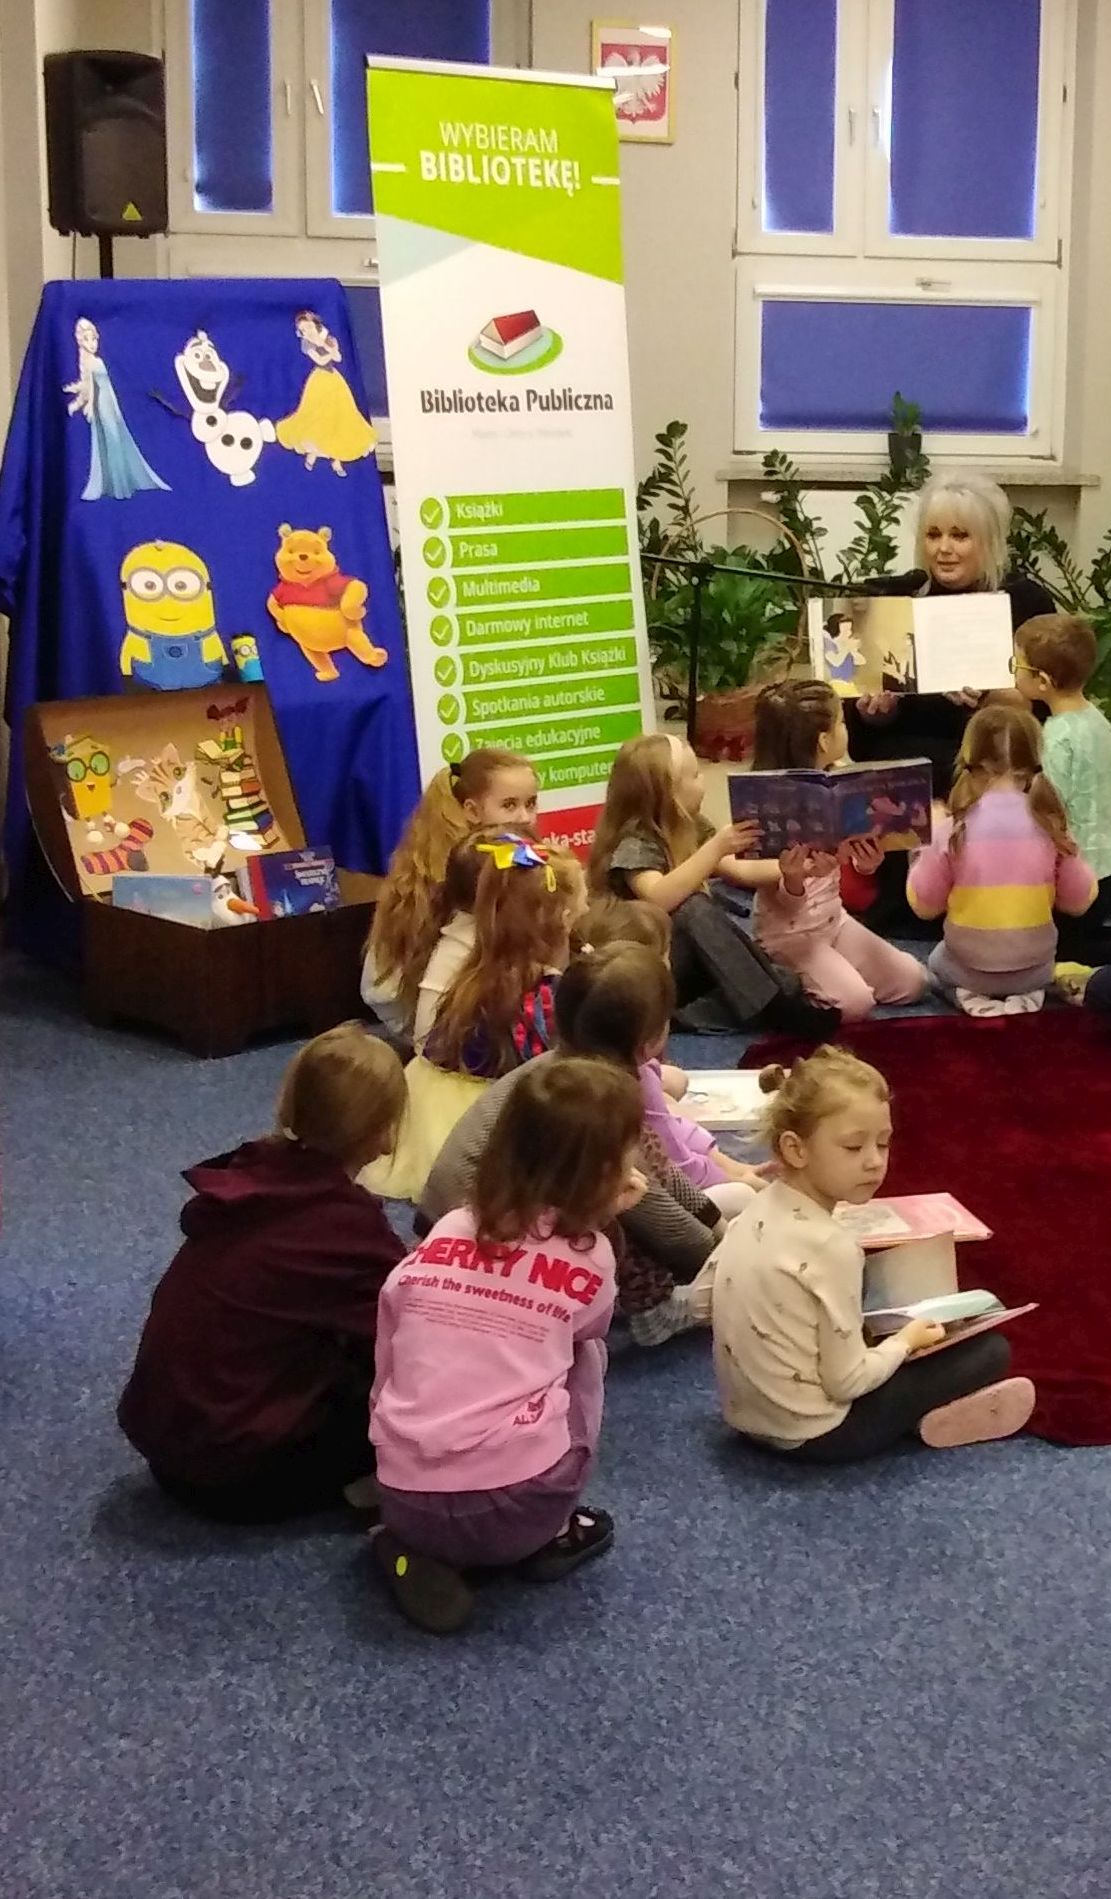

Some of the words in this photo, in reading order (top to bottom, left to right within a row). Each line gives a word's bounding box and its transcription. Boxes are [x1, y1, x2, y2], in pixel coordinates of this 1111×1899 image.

[439, 121, 558, 154] WYBIERAM
[419, 150, 581, 197] BIBLIOTEKĘ!
[420, 389, 520, 414] Biblioteka
[526, 387, 614, 412] Publiczna
[456, 502, 503, 521] Książki
[459, 541, 498, 558] Prasa
[463, 578, 540, 597] Multimedia
[466, 617, 531, 638] Darmowy
[534, 610, 589, 629] internet
[469, 655, 544, 678] Dyskusyjny
[548, 651, 578, 669] Klub
[581, 645, 626, 667] Książki
[472, 695, 540, 718] Spotkania
[543, 687, 605, 709] autorskie
[526, 726, 601, 748] edukacyjne
[550, 761, 613, 783] komputer
[528, 1252, 603, 1306] NICE
[442, 1278, 461, 1292] the
[464, 1284, 534, 1310] sweetness
[537, 1303, 553, 1315] of
[551, 1305, 571, 1323] life
